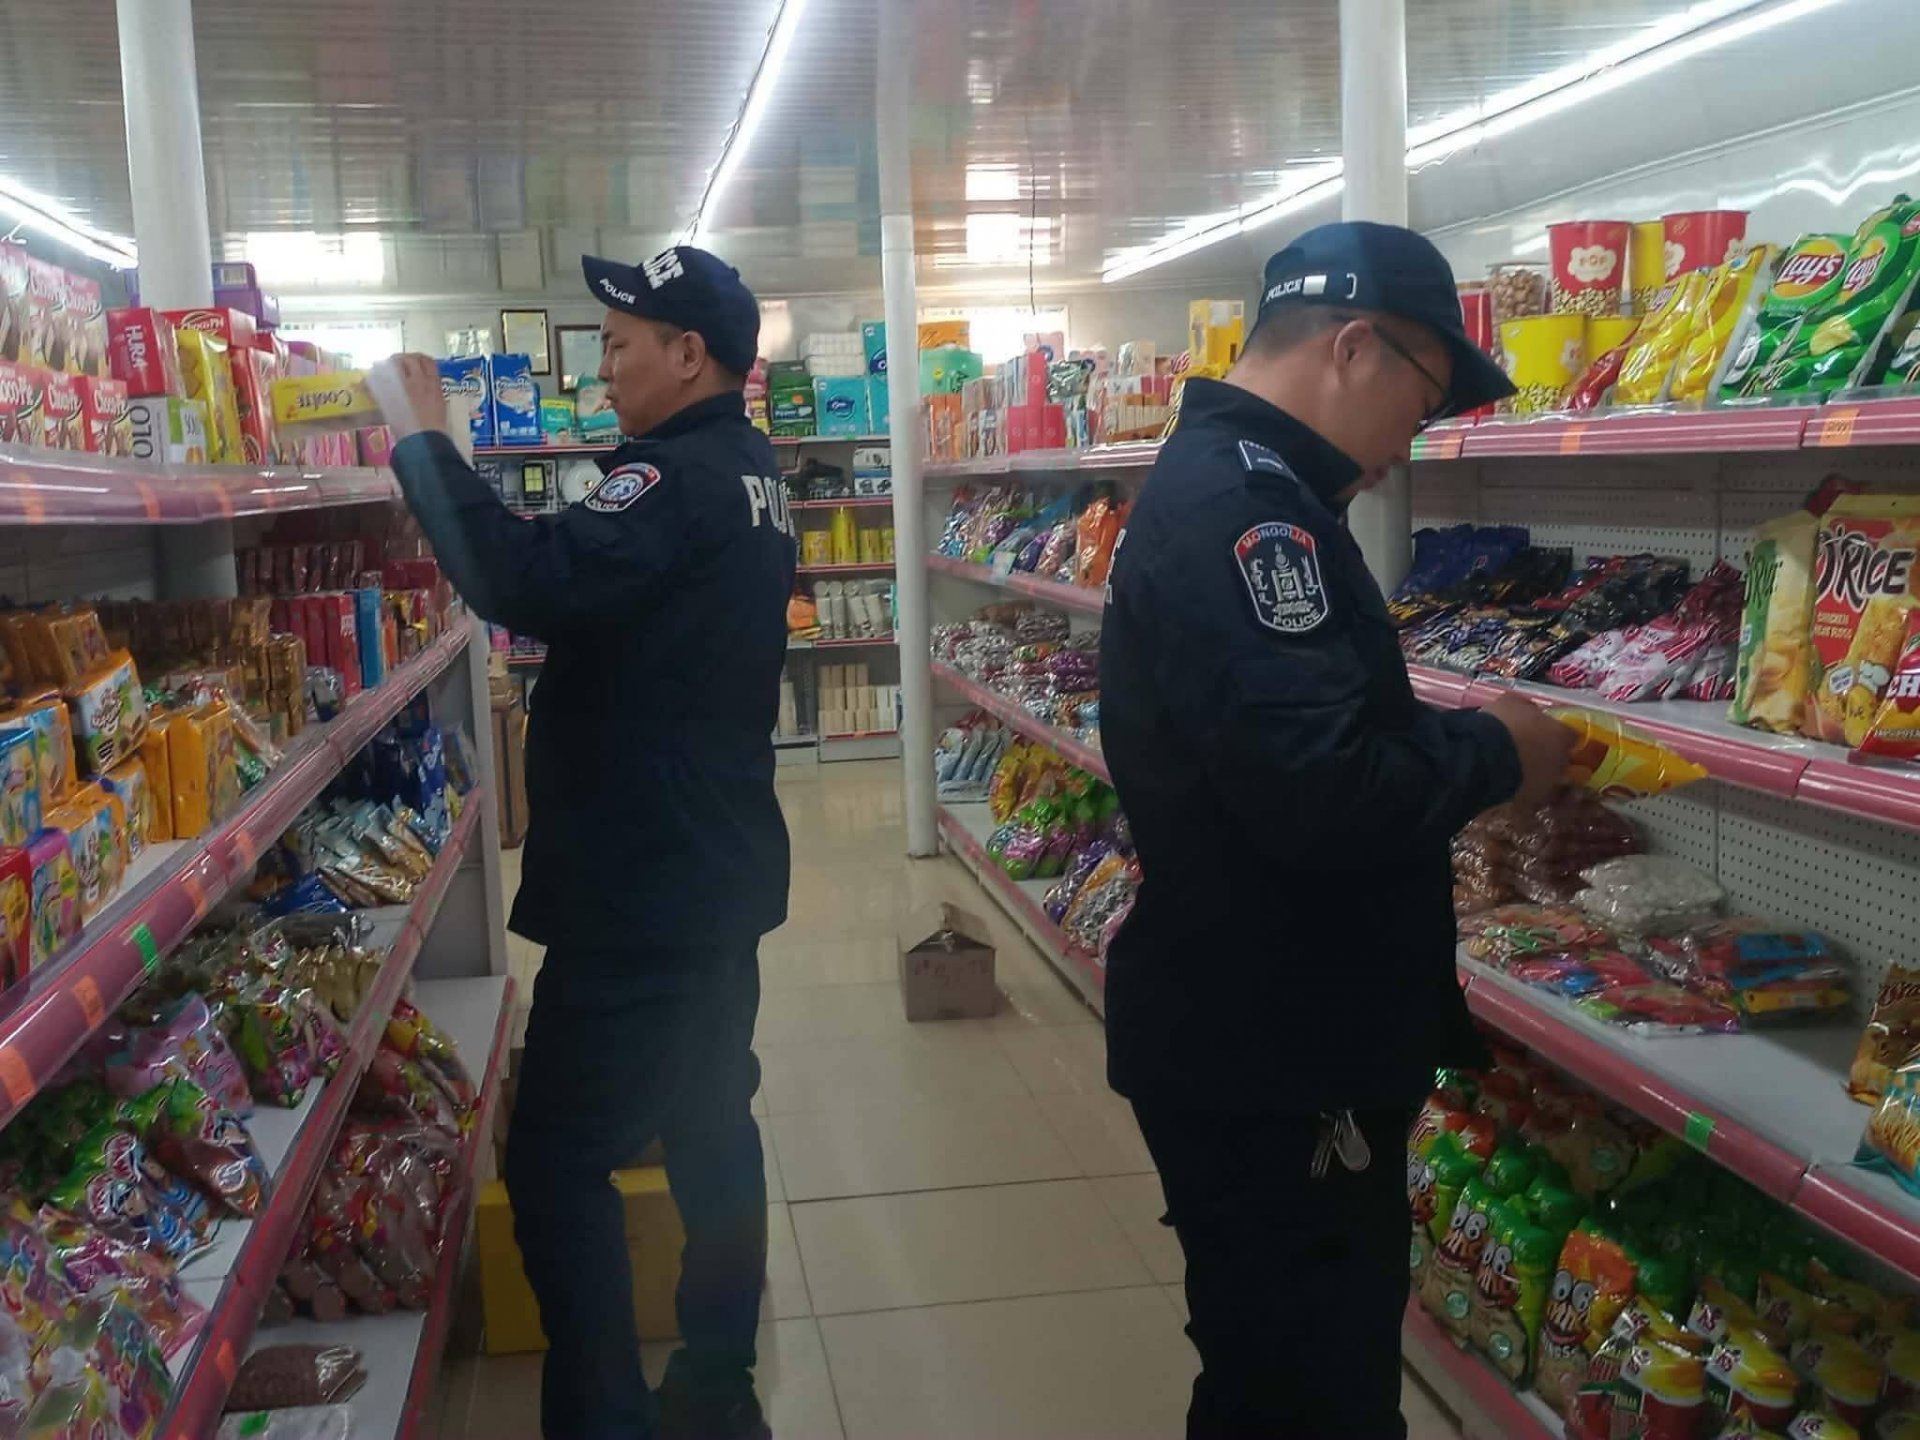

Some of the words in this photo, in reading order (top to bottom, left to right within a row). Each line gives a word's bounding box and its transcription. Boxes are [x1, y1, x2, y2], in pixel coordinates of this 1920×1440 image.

[599, 278, 636, 304] POLICE
[1243, 526, 1306, 549] MONGOLIA
[1273, 608, 1321, 628] POLICE
